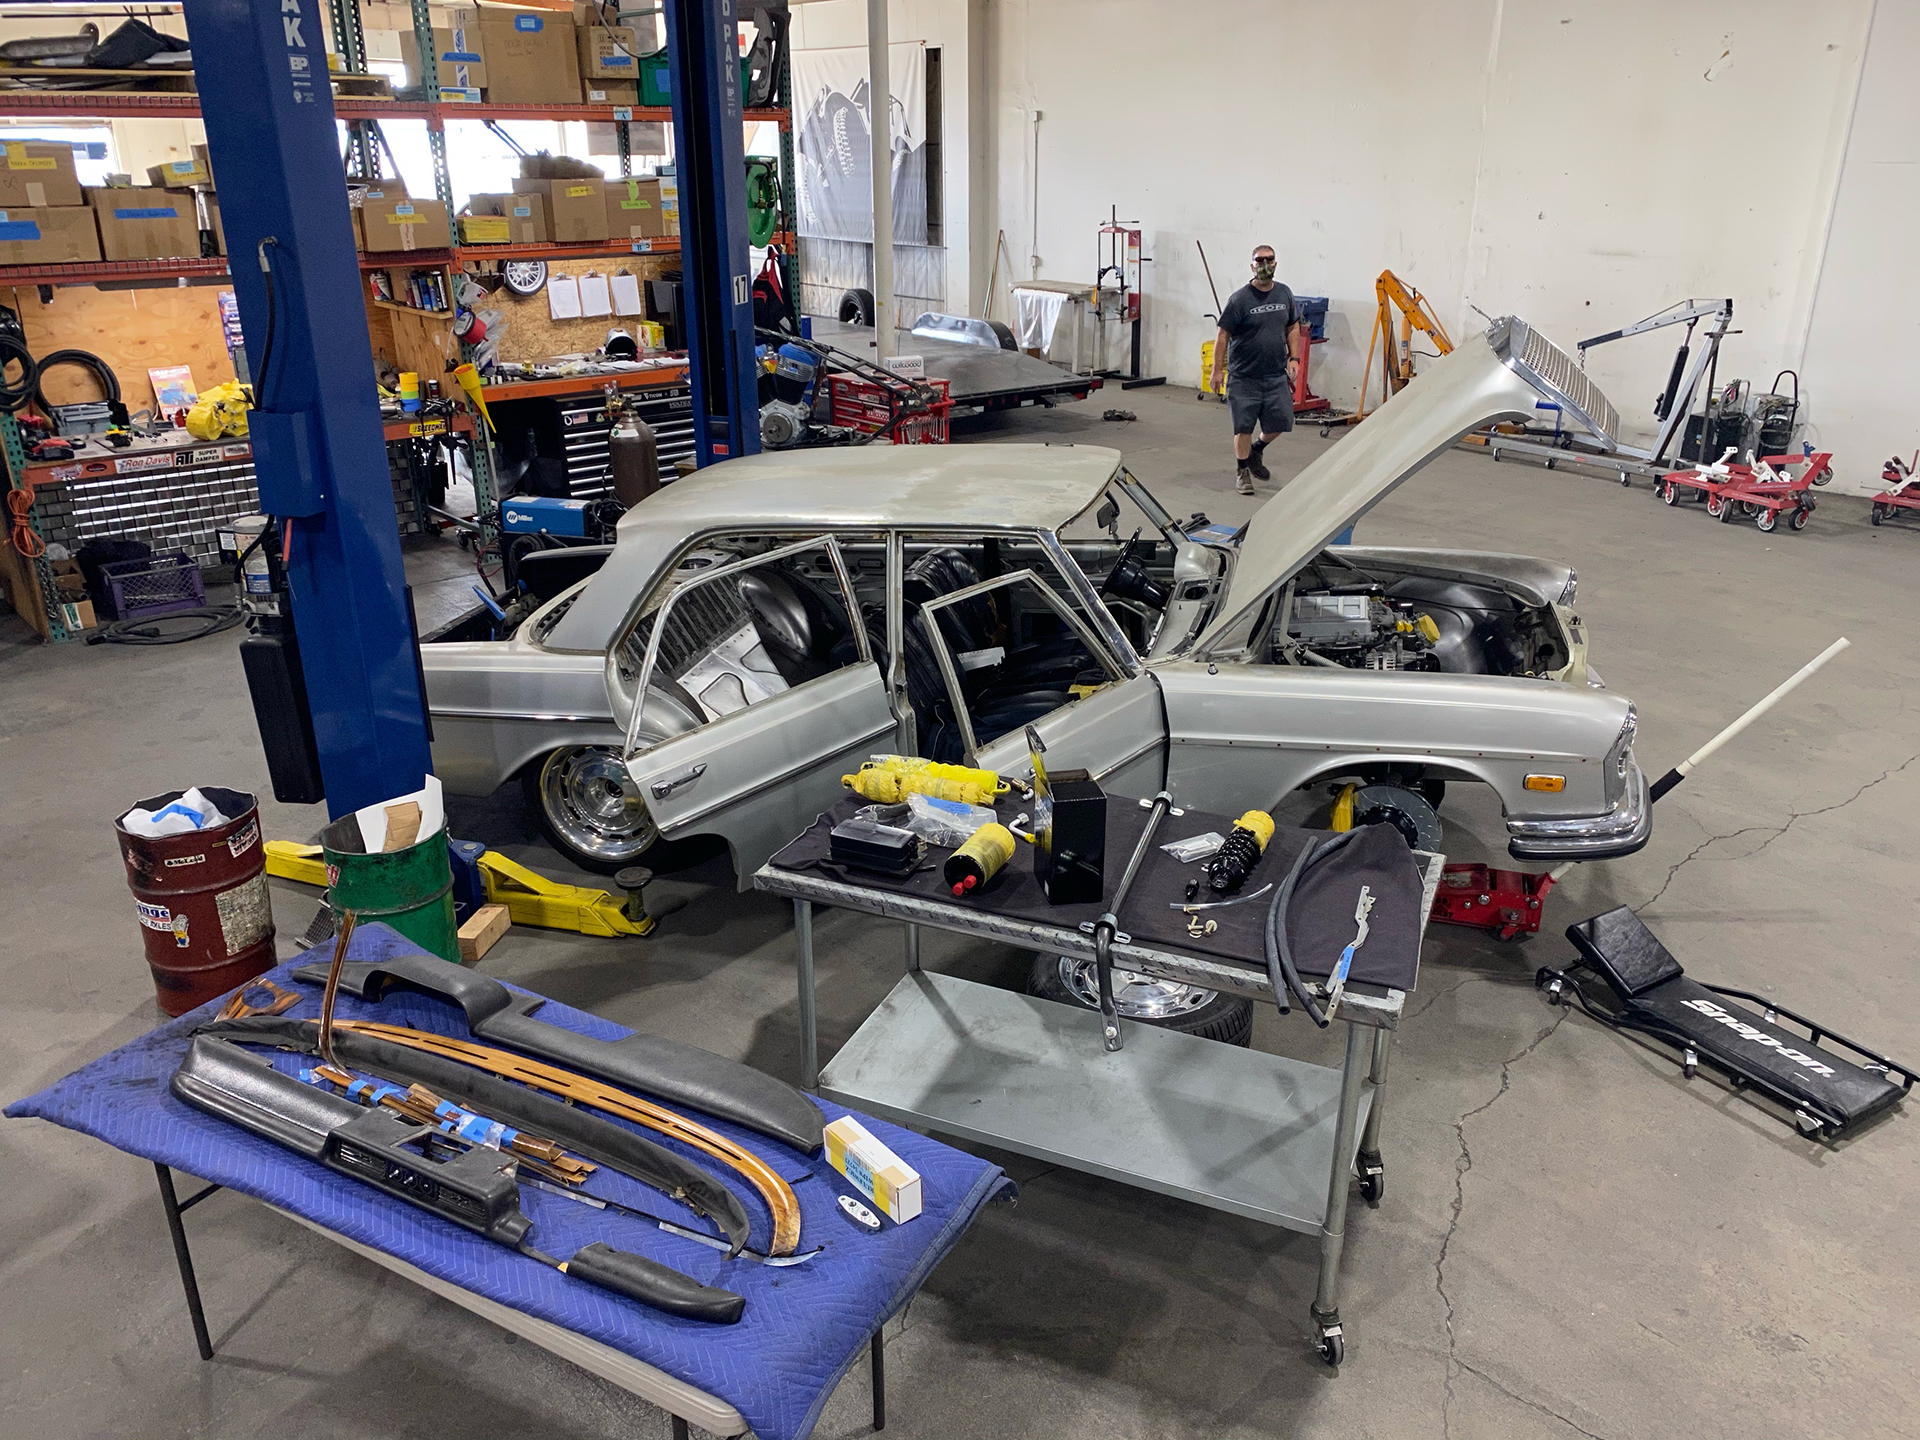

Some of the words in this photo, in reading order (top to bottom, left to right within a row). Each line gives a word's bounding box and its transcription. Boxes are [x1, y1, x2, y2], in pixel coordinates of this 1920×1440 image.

[735, 276, 746, 303] 17
[1251, 304, 1286, 314] ICON
[125, 459, 143, 467] Ron
[146, 455, 170, 465] Davis
[176, 451, 193, 465] ATI
